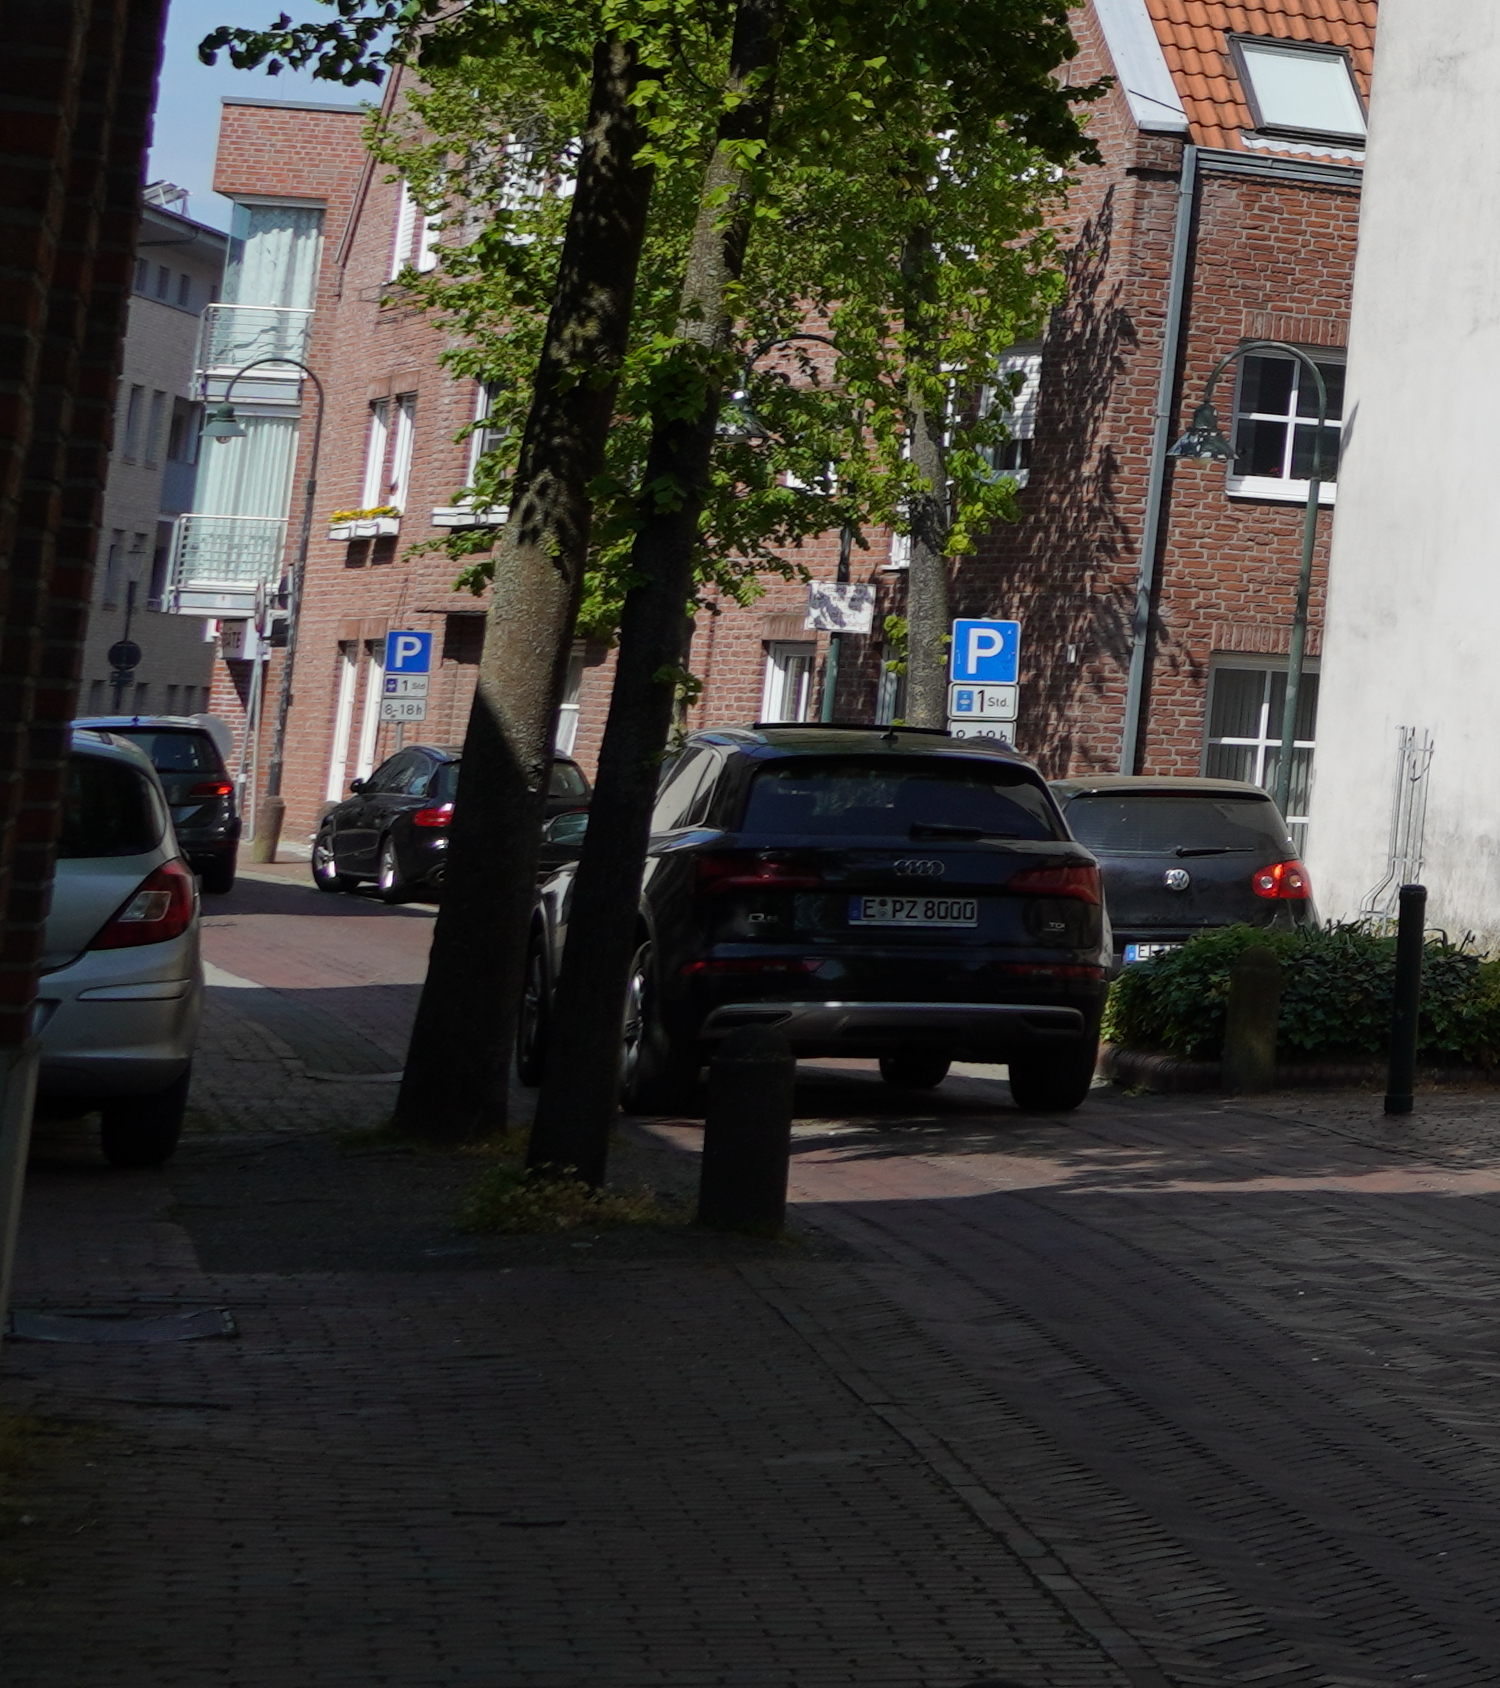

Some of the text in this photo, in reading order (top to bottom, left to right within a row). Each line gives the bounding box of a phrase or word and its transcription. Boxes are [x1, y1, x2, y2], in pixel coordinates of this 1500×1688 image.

[395, 636, 422, 668] P
[967, 628, 1004, 674] P
[977, 689, 1010, 713] 1 Std.
[863, 899, 975, 920] E PZ 8000
